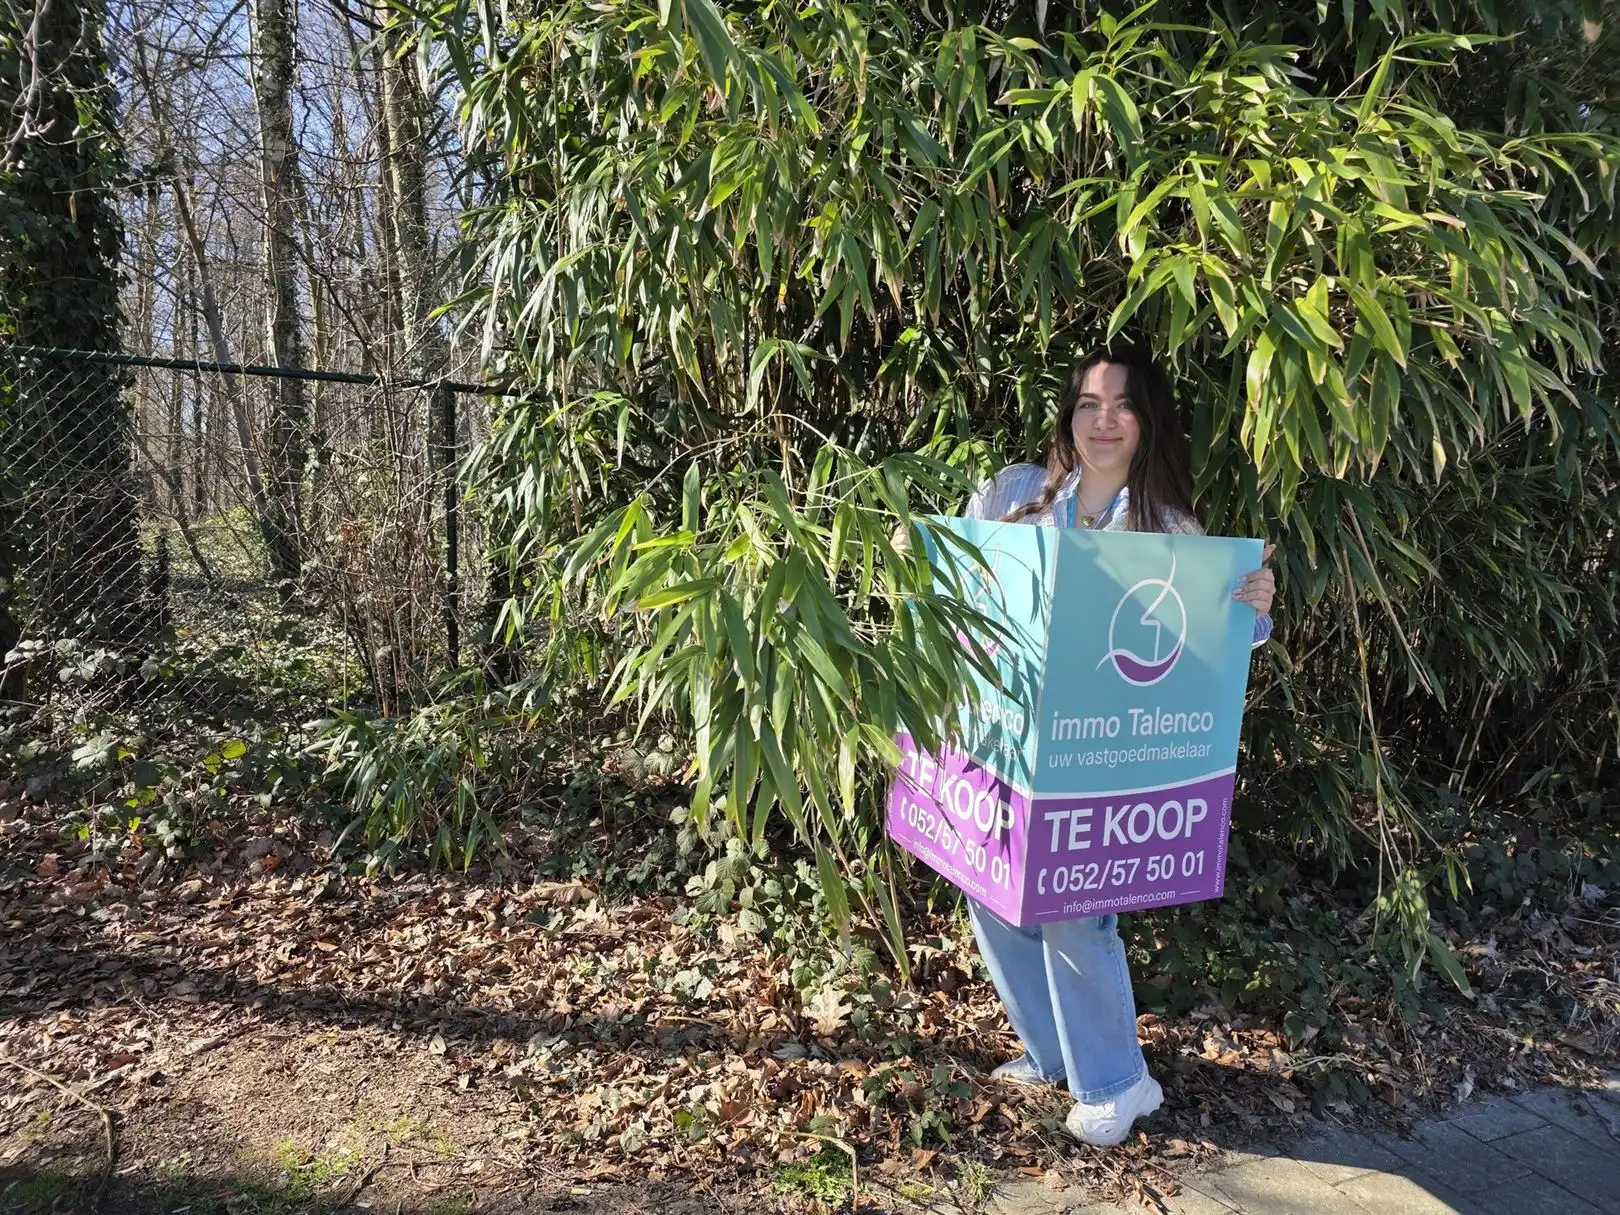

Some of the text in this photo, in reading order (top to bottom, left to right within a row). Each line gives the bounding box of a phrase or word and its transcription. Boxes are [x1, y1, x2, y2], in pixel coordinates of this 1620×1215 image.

[1051, 706, 1214, 741] immo Talenco
[1049, 741, 1212, 769] uw vastgoedmakelaar
[908, 750, 935, 799] TE
[940, 770, 1015, 841] KOOP
[908, 803, 962, 856] 052/57
[964, 840, 987, 873] 50
[991, 856, 1010, 890] 01
[1044, 798, 1208, 853] TE KOOP
[1214, 797, 1228, 893] www.immotalenco.com
[1052, 850, 1204, 895] 052/57 50 01
[1063, 889, 1176, 914] info@immotalenco.com
